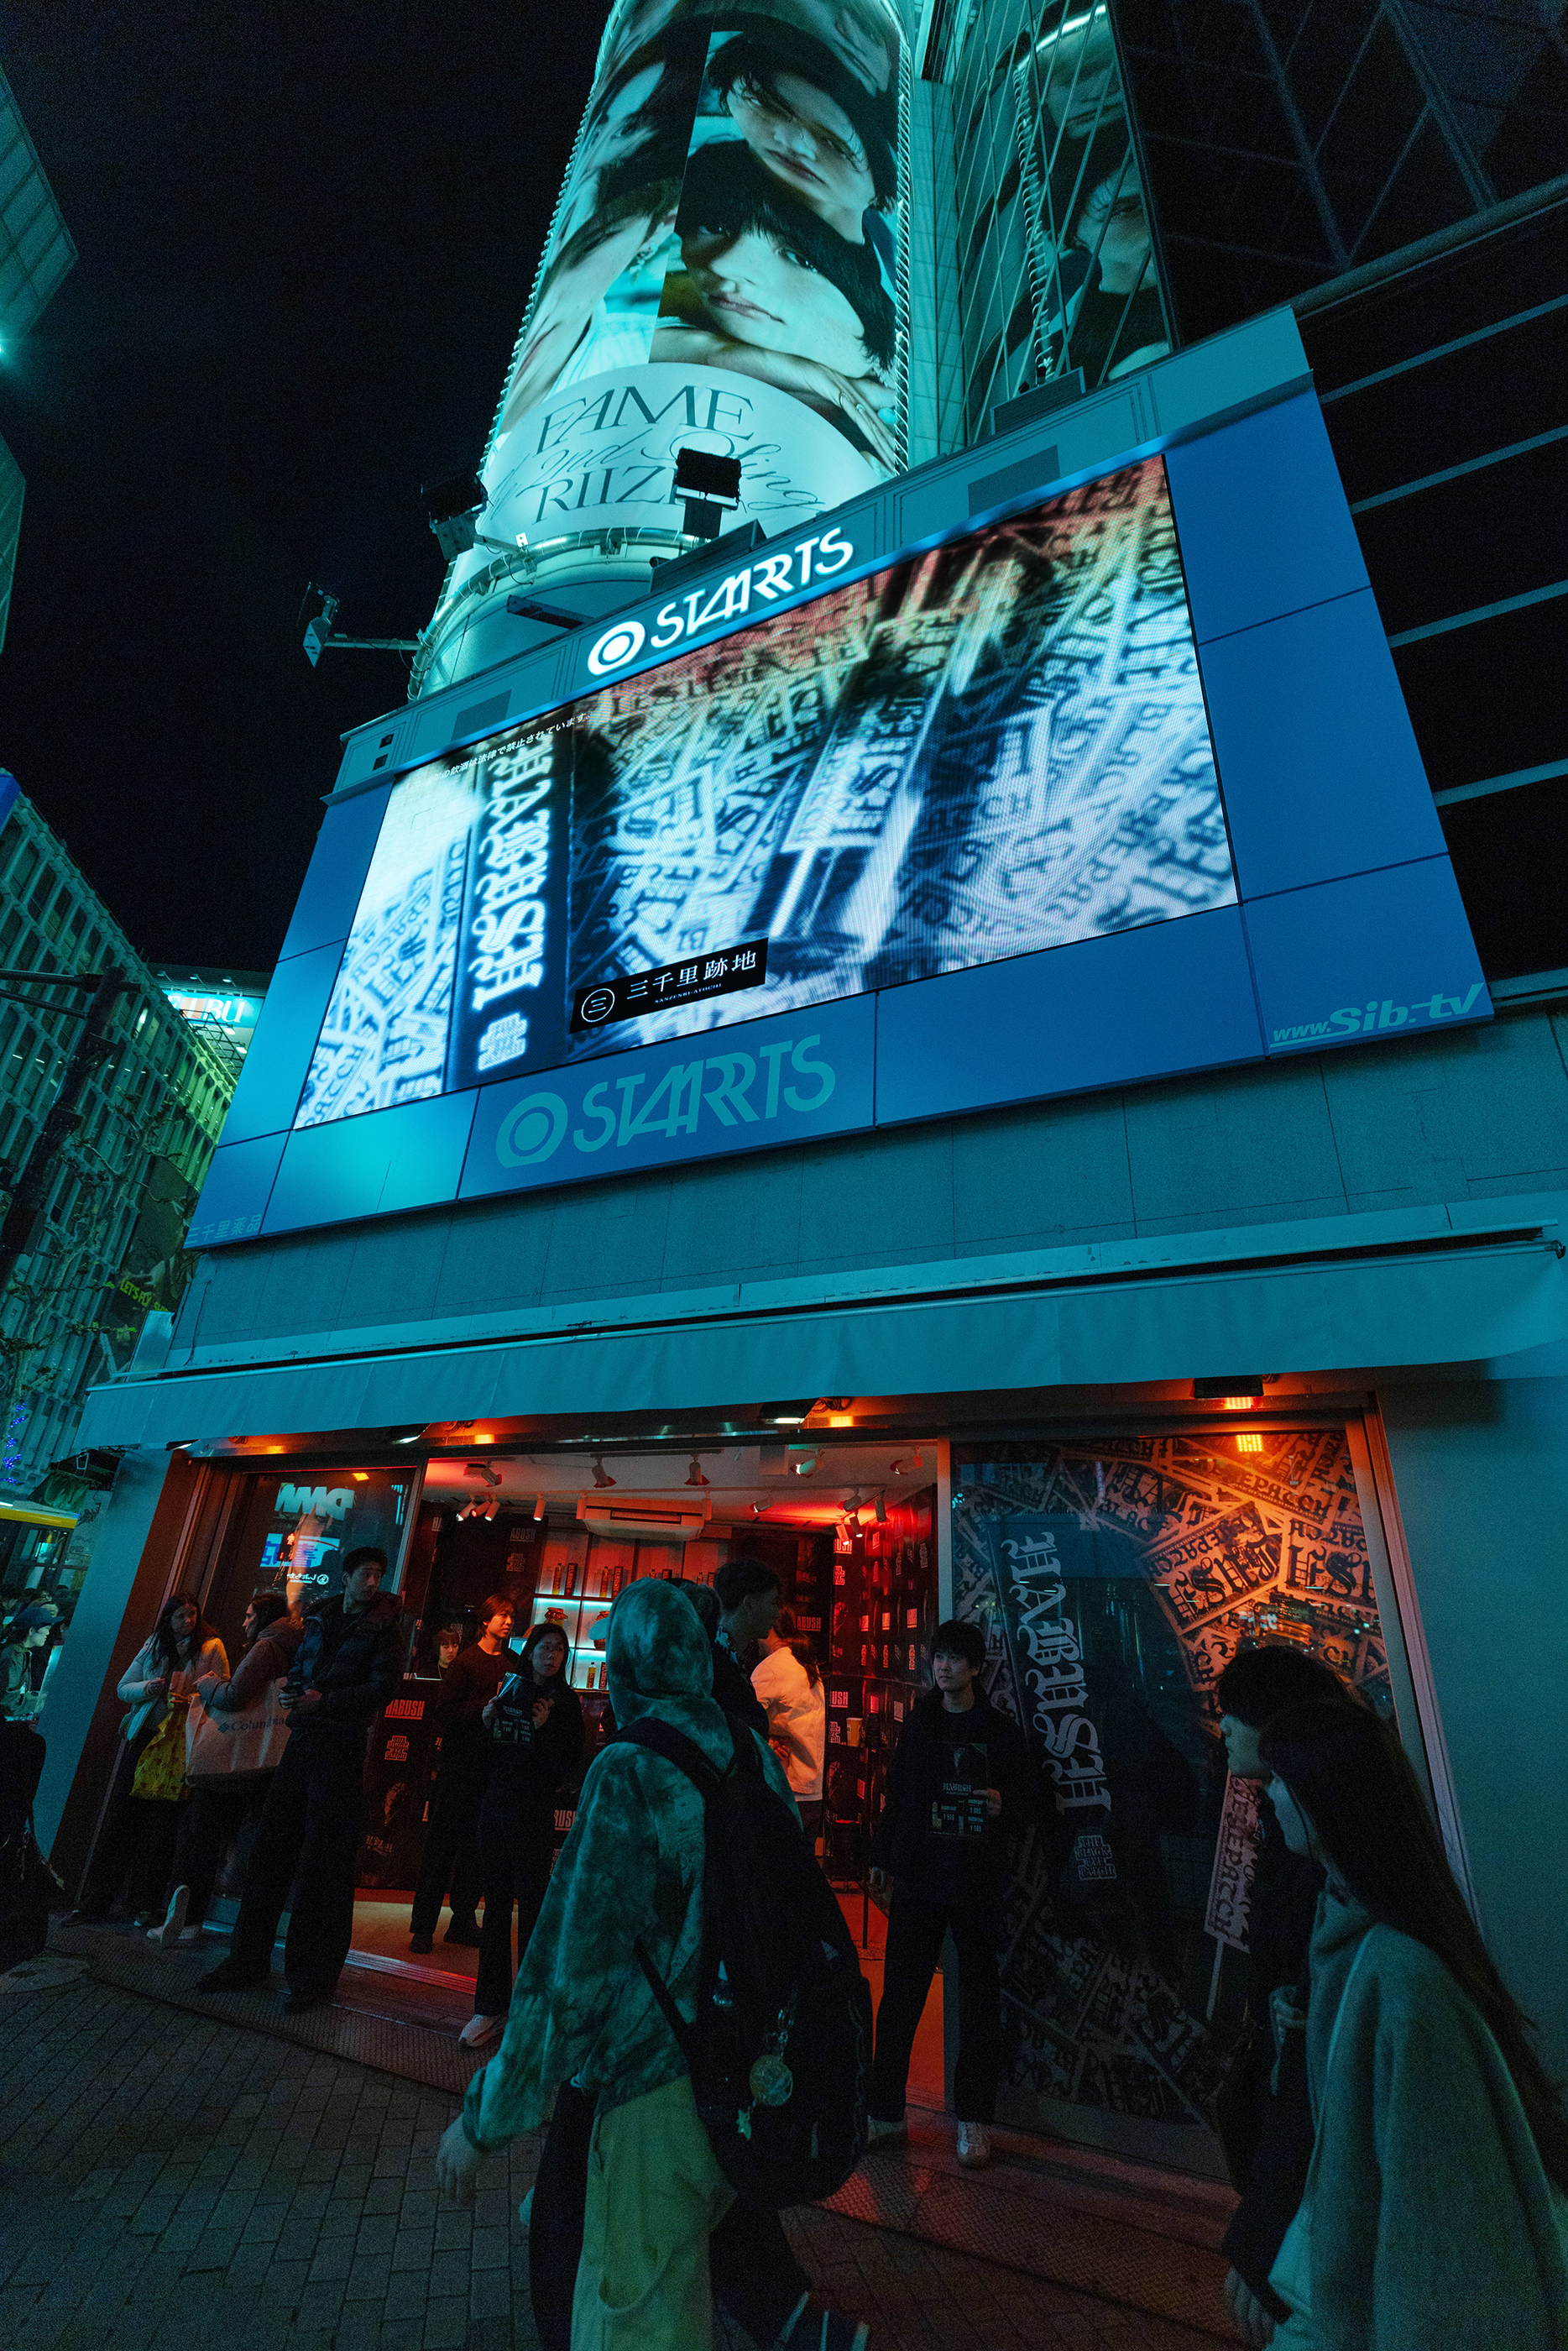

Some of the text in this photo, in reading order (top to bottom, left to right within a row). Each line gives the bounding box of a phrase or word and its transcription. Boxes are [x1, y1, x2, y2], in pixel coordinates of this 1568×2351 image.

[532, 385, 755, 458] FAME
[626, 950, 757, 1000] 三千里跡地
[184, 1213, 262, 1245] 三千里薬品
[1000, 1531, 1111, 1819] HABUSH
